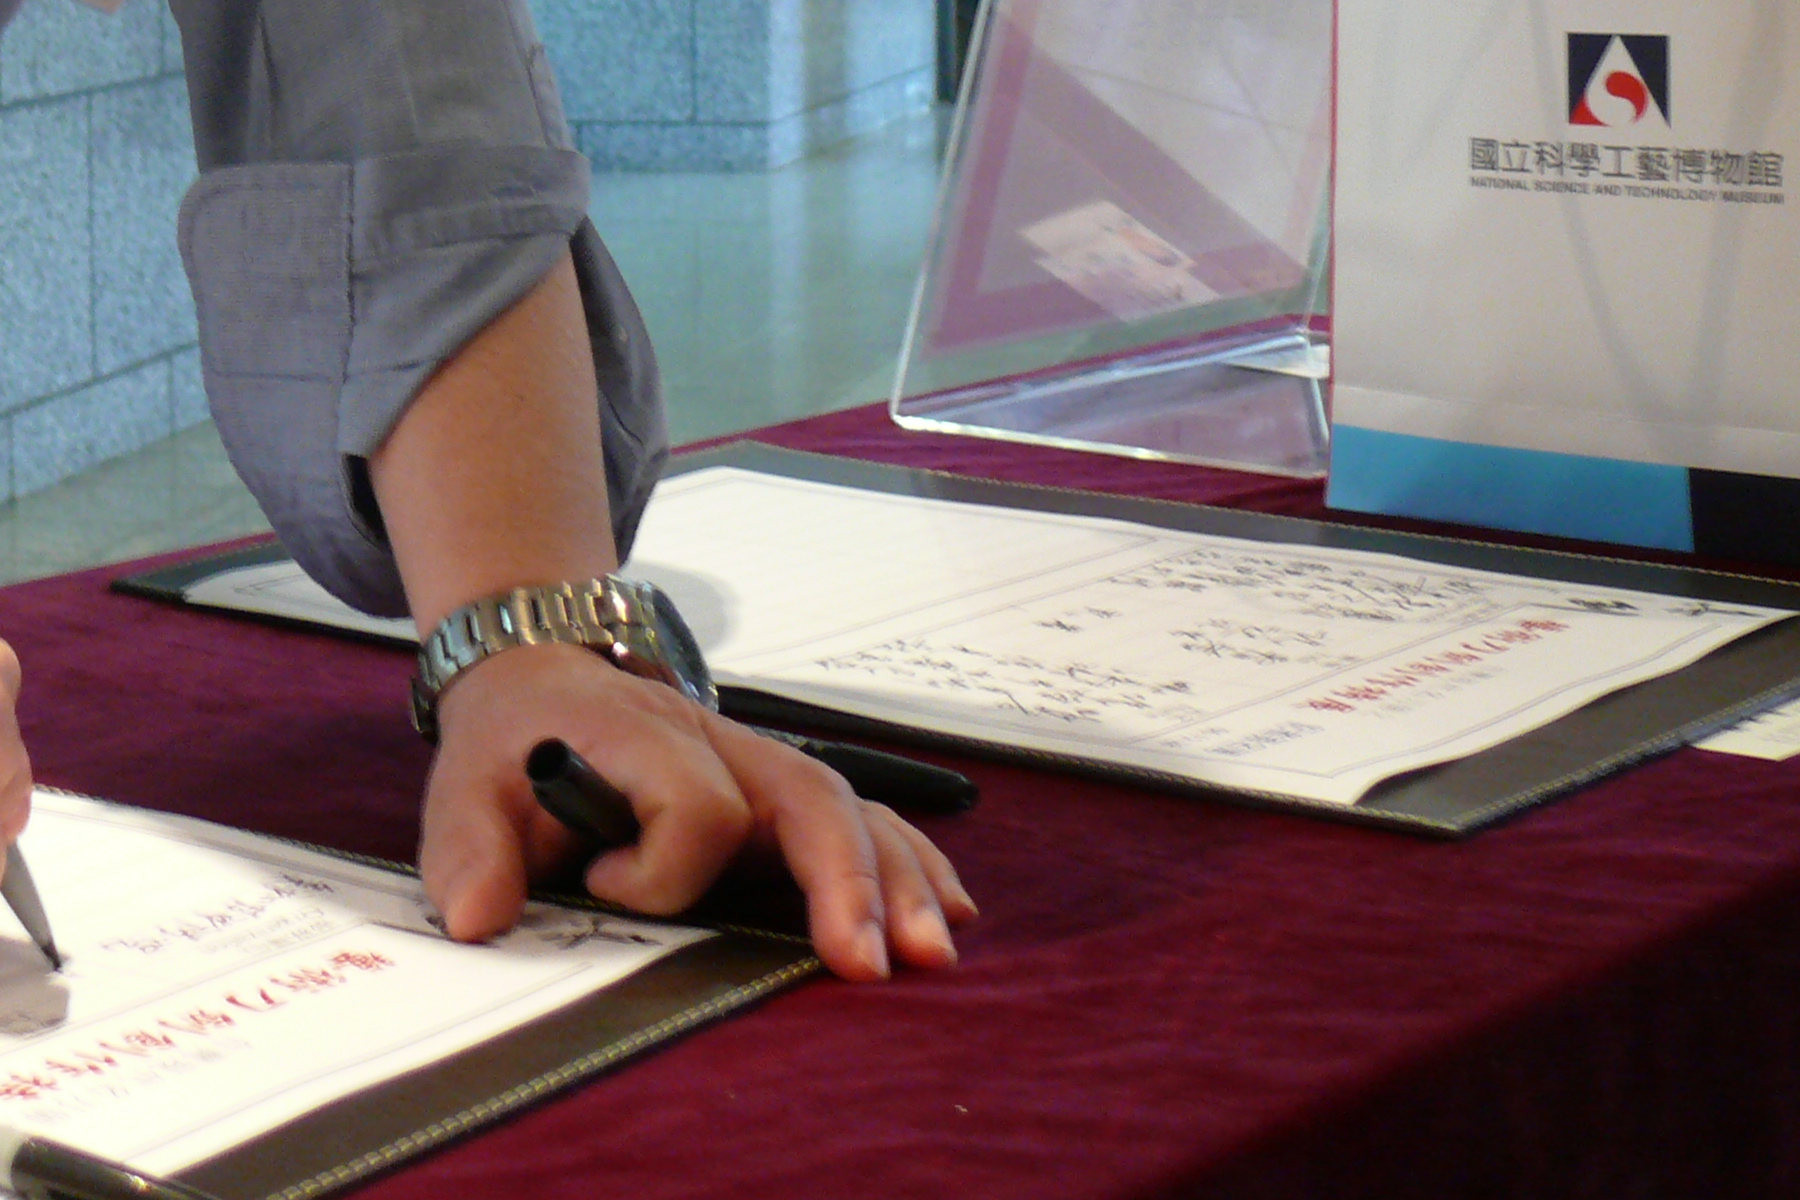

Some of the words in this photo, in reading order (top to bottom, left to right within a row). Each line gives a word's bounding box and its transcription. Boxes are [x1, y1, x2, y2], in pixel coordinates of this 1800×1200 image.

[1469, 137, 1784, 188] 國立科學工藝博物館
[1471, 176, 1530, 192] NATIONAL
[1534, 180, 1590, 195] SCIENCE
[1594, 184, 1622, 197] AND
[1624, 185, 1718, 202] TECHNOLOGY
[1722, 190, 1785, 205] MUSEUM
